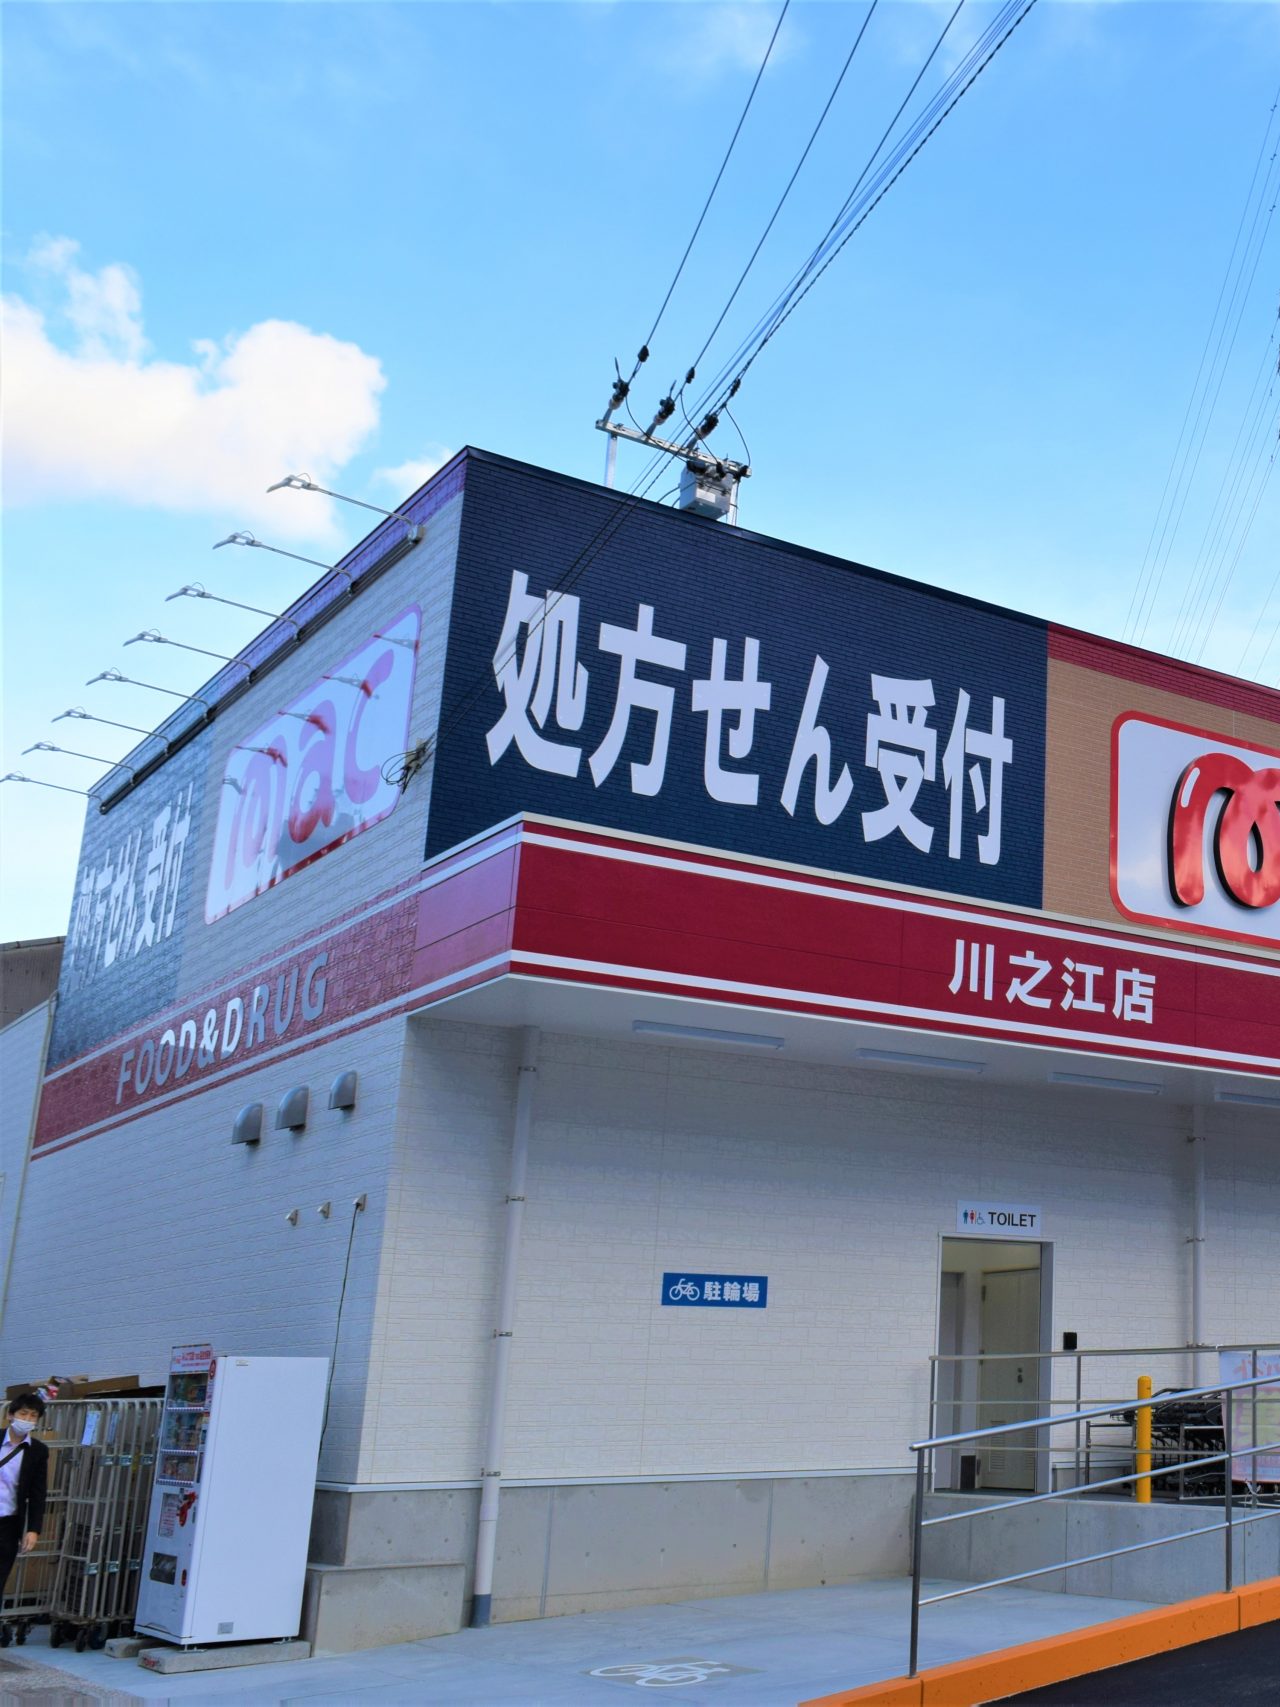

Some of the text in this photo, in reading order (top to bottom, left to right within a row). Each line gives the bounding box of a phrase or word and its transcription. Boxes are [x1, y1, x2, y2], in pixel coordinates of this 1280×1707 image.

[486, 569, 1013, 866] 処方せん受付
[948, 939, 1156, 1024] 川之江店
[116, 952, 329, 1105] FOOD&DRUG
[988, 1211, 1036, 1227] TOILET
[703, 1281, 760, 1302] 駐輪場
